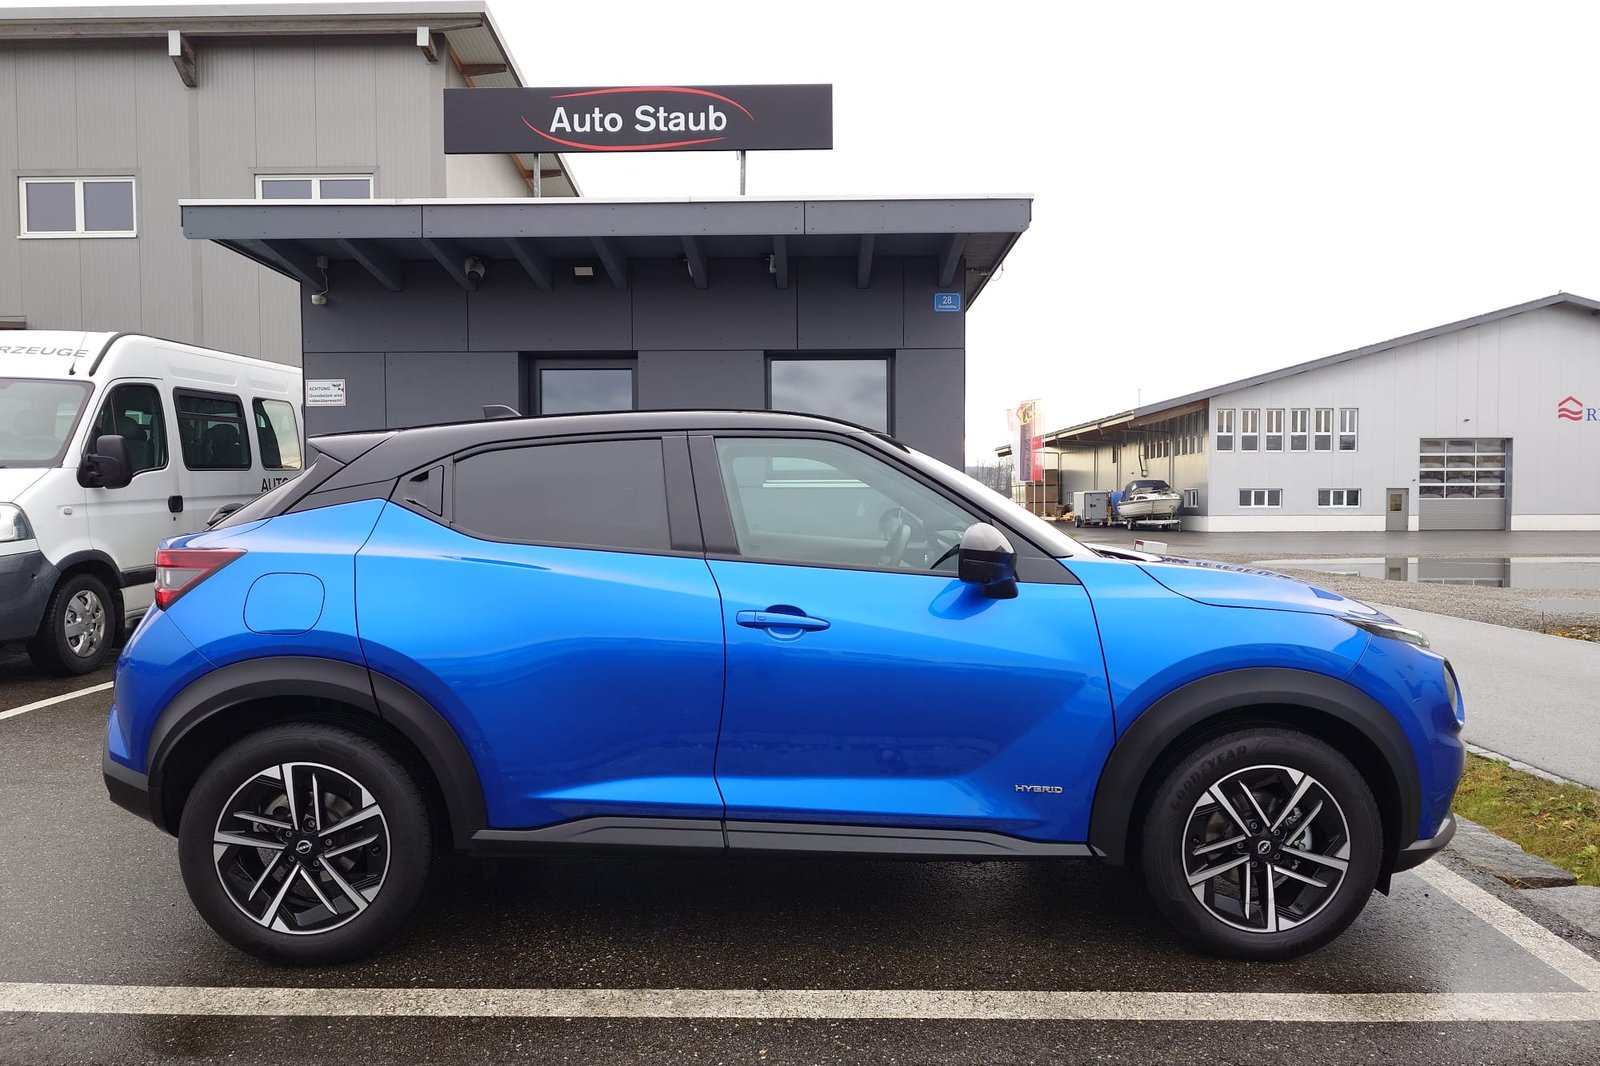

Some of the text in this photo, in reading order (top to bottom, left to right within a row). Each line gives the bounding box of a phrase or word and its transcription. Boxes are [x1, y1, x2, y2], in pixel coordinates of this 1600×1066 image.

[550, 105, 727, 132] Auto Staub
[942, 296, 952, 305] 28
[1586, 408, 1600, 421] R
[1015, 784, 1063, 793] HYBRID
